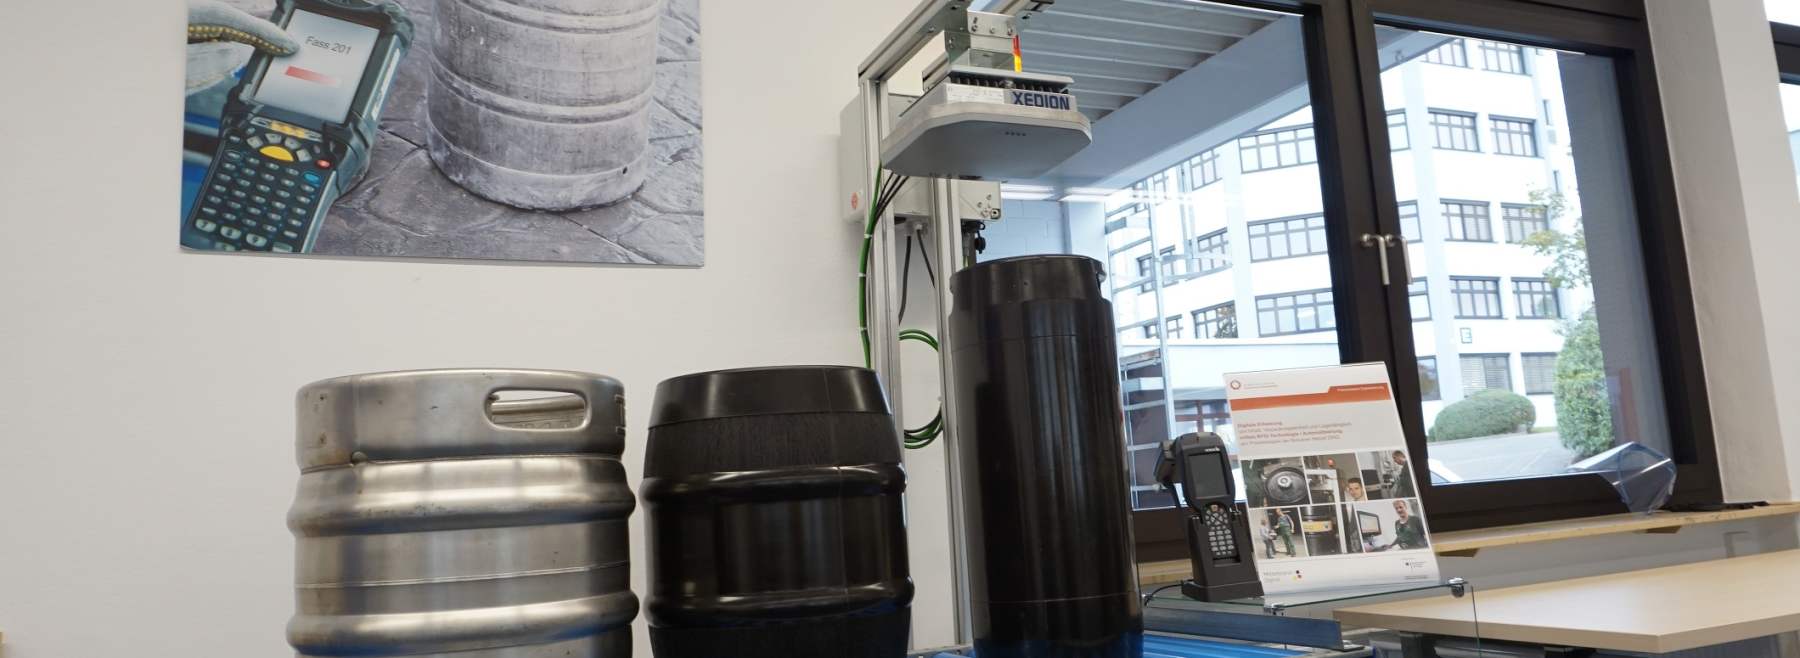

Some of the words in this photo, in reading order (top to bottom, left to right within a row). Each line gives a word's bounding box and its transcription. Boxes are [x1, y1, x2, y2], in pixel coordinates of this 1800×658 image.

[305, 36, 330, 49] Fass
[331, 43, 352, 56] 201
[1012, 91, 1070, 110] XEDION
